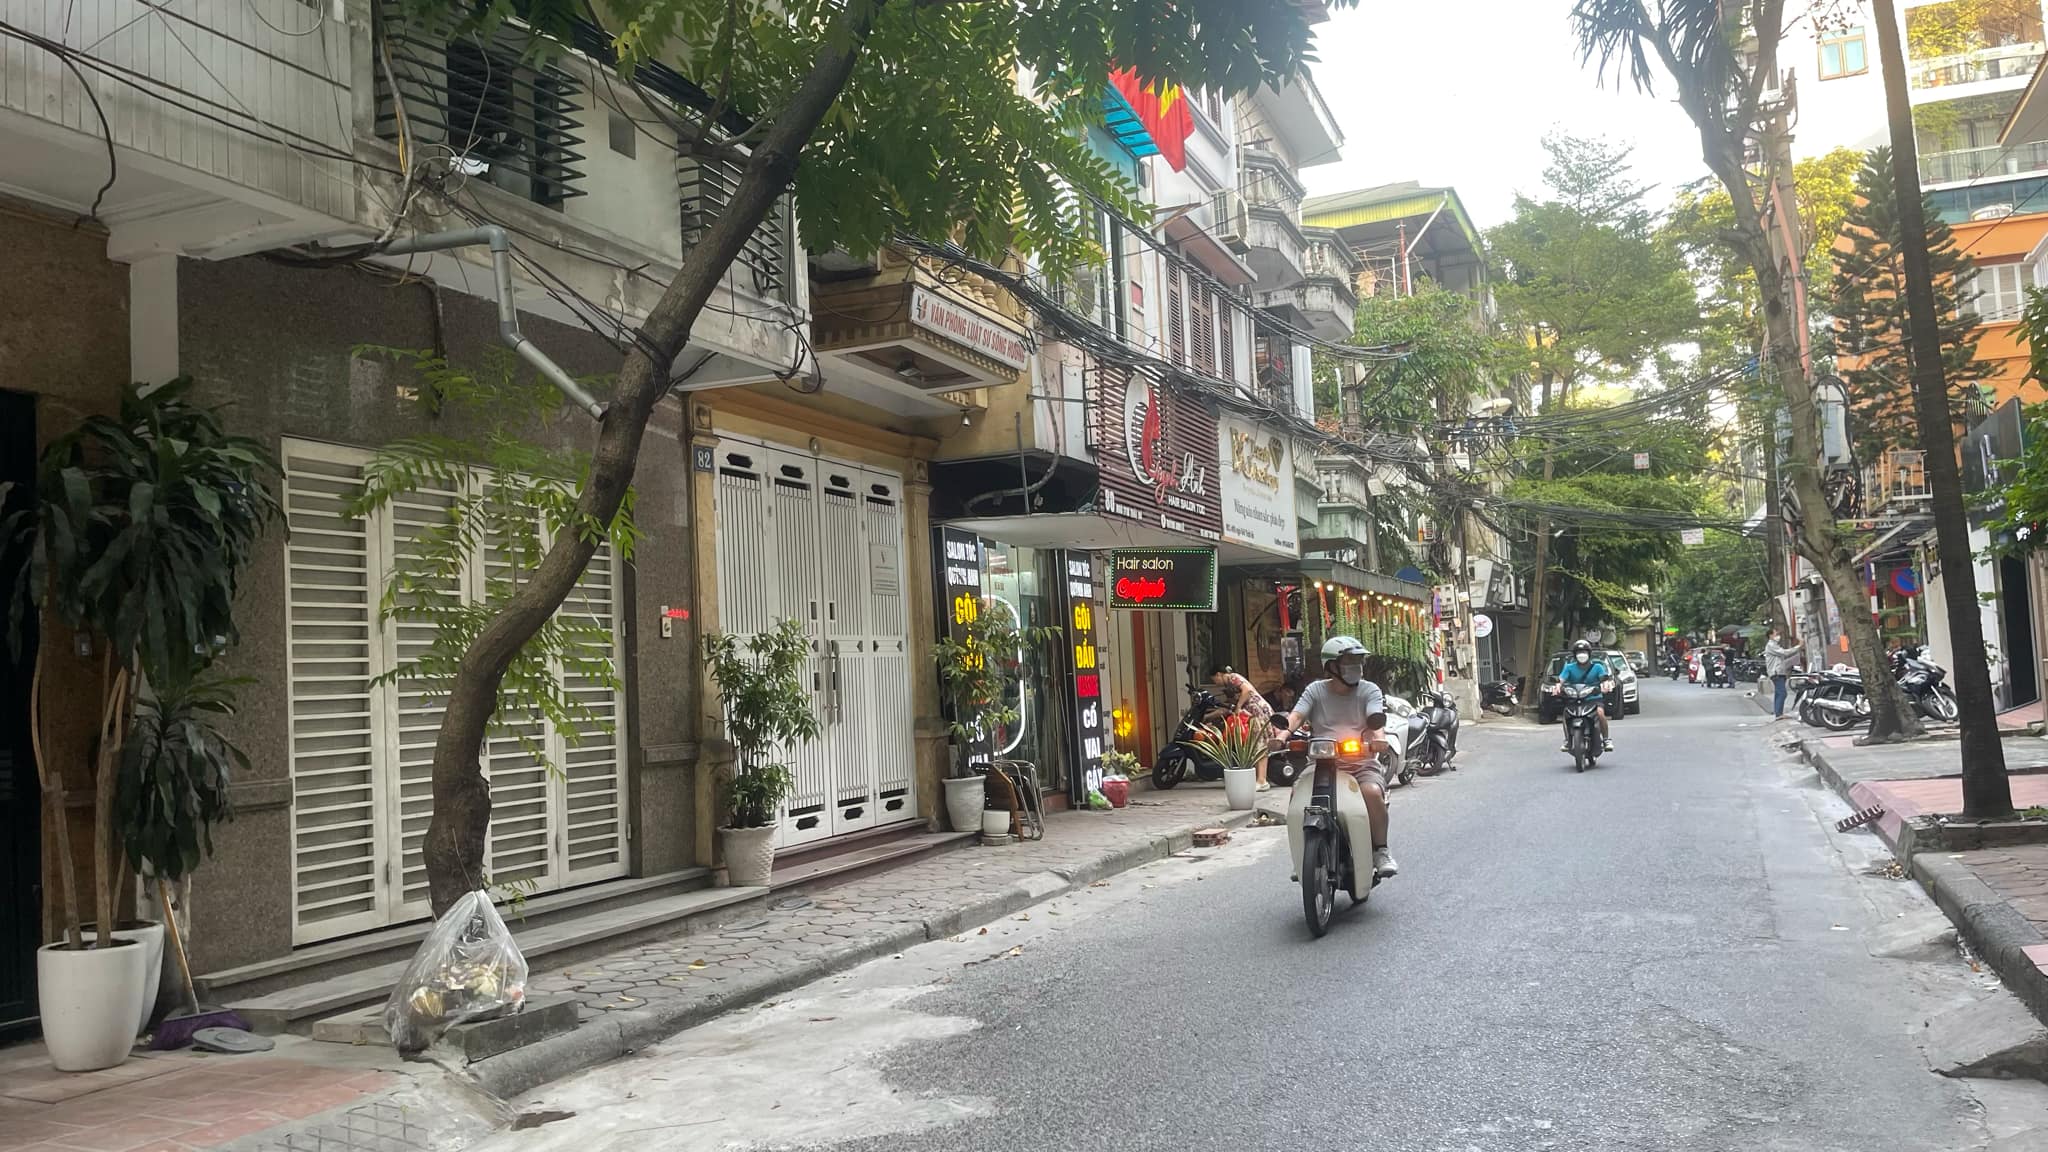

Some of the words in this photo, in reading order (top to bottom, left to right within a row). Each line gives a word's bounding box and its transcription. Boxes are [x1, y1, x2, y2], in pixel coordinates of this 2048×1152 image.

[945, 310, 967, 338] PHÒNG
[697, 449, 711, 468] 82
[946, 540, 966, 561] SALON
[1117, 557, 1140, 570] Hair
[1141, 557, 1174, 570] salon
[1075, 637, 1096, 670] ĐẦU
[1084, 736, 1101, 760] VAI
[1085, 765, 1103, 791] GÁY
